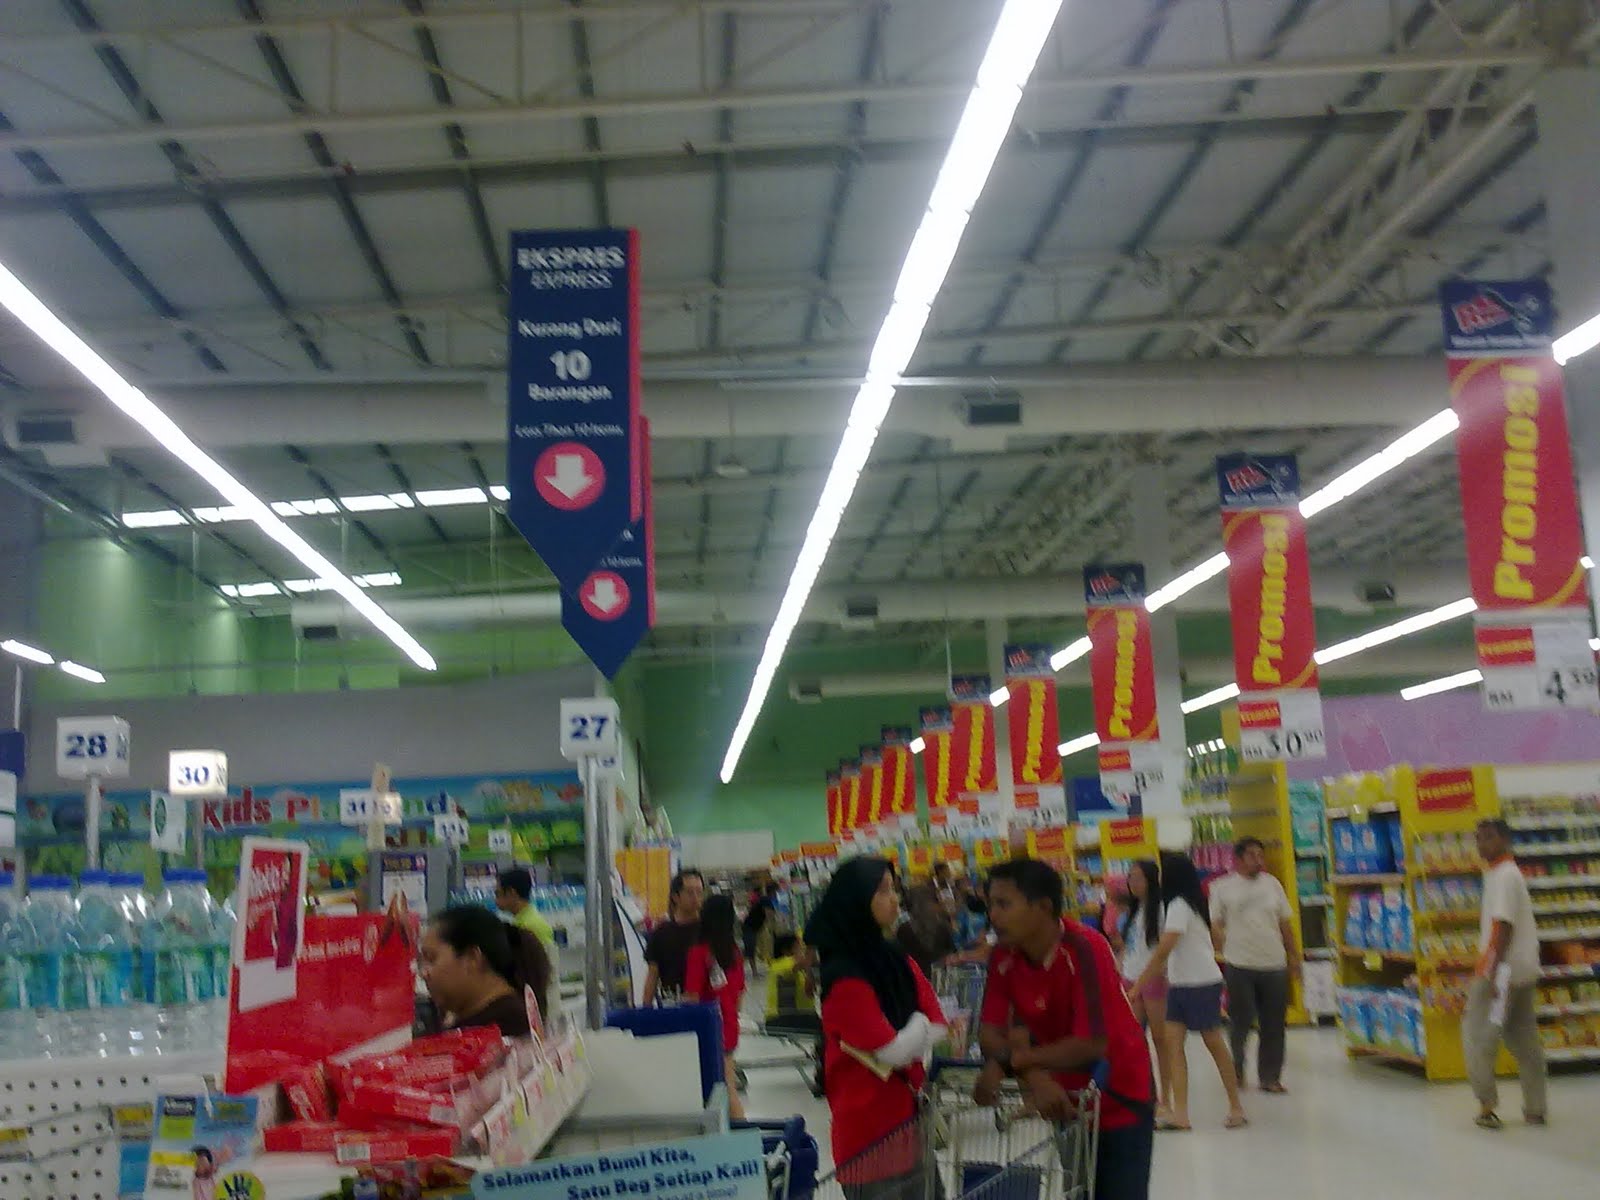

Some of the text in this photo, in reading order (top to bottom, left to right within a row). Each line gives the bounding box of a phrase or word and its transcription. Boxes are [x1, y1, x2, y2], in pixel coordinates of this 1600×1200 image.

[516, 246, 625, 270] EKSPRES
[549, 349, 593, 381] 10
[1494, 364, 1540, 600] Promosi
[1252, 513, 1289, 684] Promosi
[570, 715, 609, 740] 27
[66, 734, 108, 758] 28
[176, 766, 210, 786] 30
[203, 786, 274, 832] Kids
[482, 1147, 696, 1190] Selamatkan Bumi Kita,
[566, 1183, 611, 1200] Satu
[614, 1177, 650, 1195] Beg
[654, 1168, 713, 1188] Setiap
